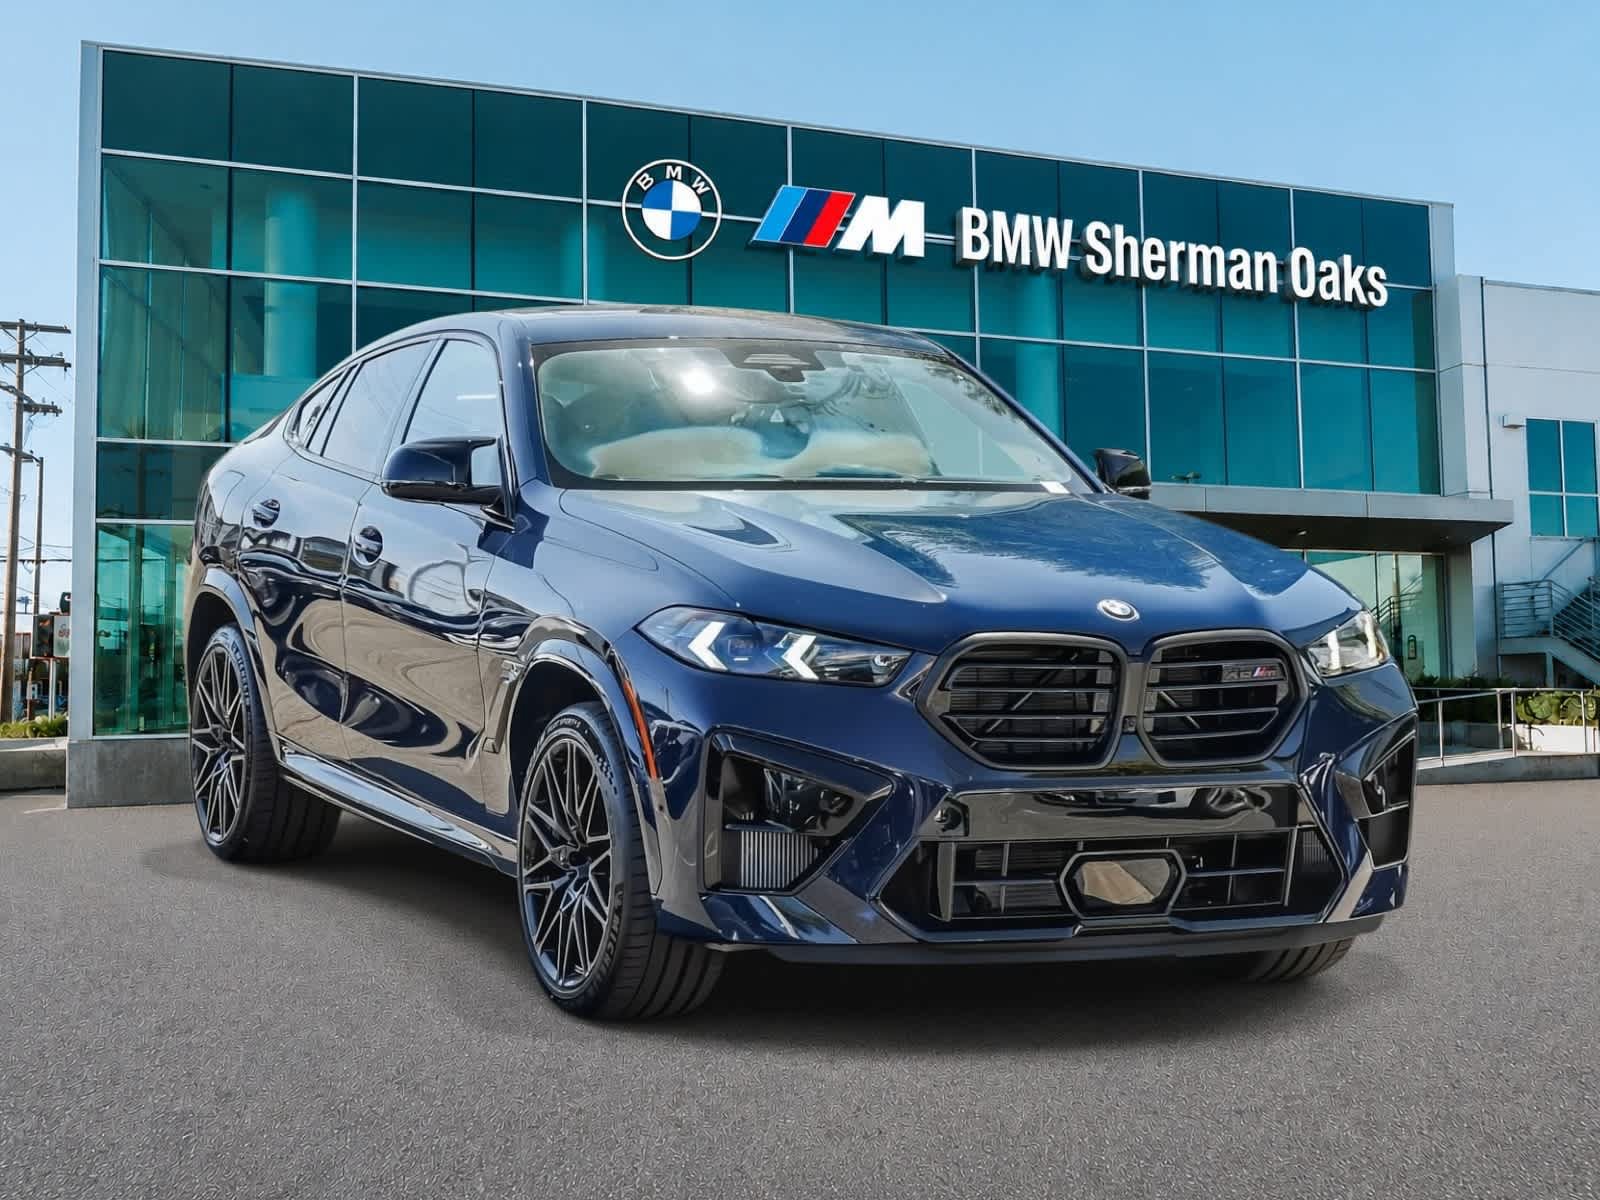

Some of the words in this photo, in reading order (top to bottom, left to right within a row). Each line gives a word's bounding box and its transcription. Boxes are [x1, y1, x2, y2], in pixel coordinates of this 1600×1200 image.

[636, 165, 711, 195] BMW
[834, 195, 925, 257] M
[960, 206, 1074, 270] BMW
[1084, 220, 1278, 294] Sherman
[1290, 247, 1389, 307] Oaks
